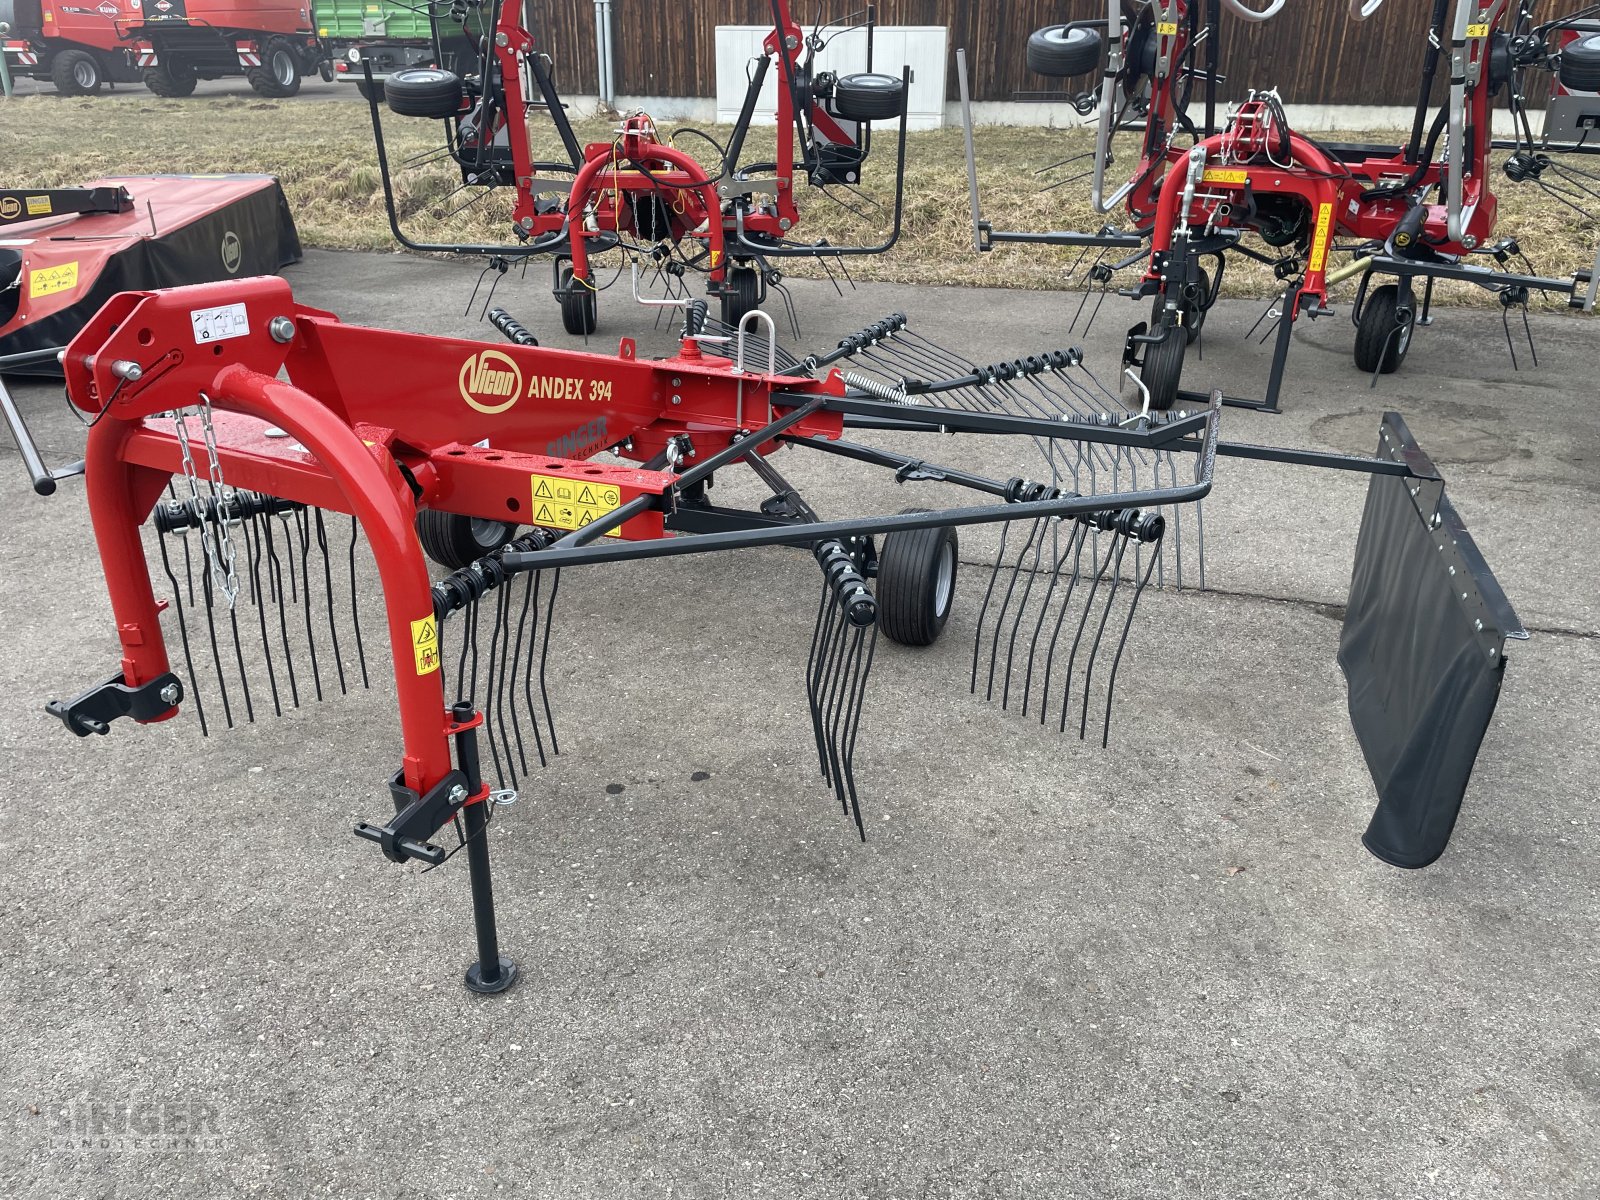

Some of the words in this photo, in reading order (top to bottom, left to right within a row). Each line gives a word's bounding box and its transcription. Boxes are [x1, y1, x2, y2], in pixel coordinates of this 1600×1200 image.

[99, 6, 118, 14] KUHN
[350, 50, 358, 59] 40
[465, 350, 517, 397] Vicon
[528, 375, 584, 400] ANDEX
[589, 379, 612, 402] 394
[546, 415, 608, 459] SINGER
[572, 438, 609, 460] TECHNIK
